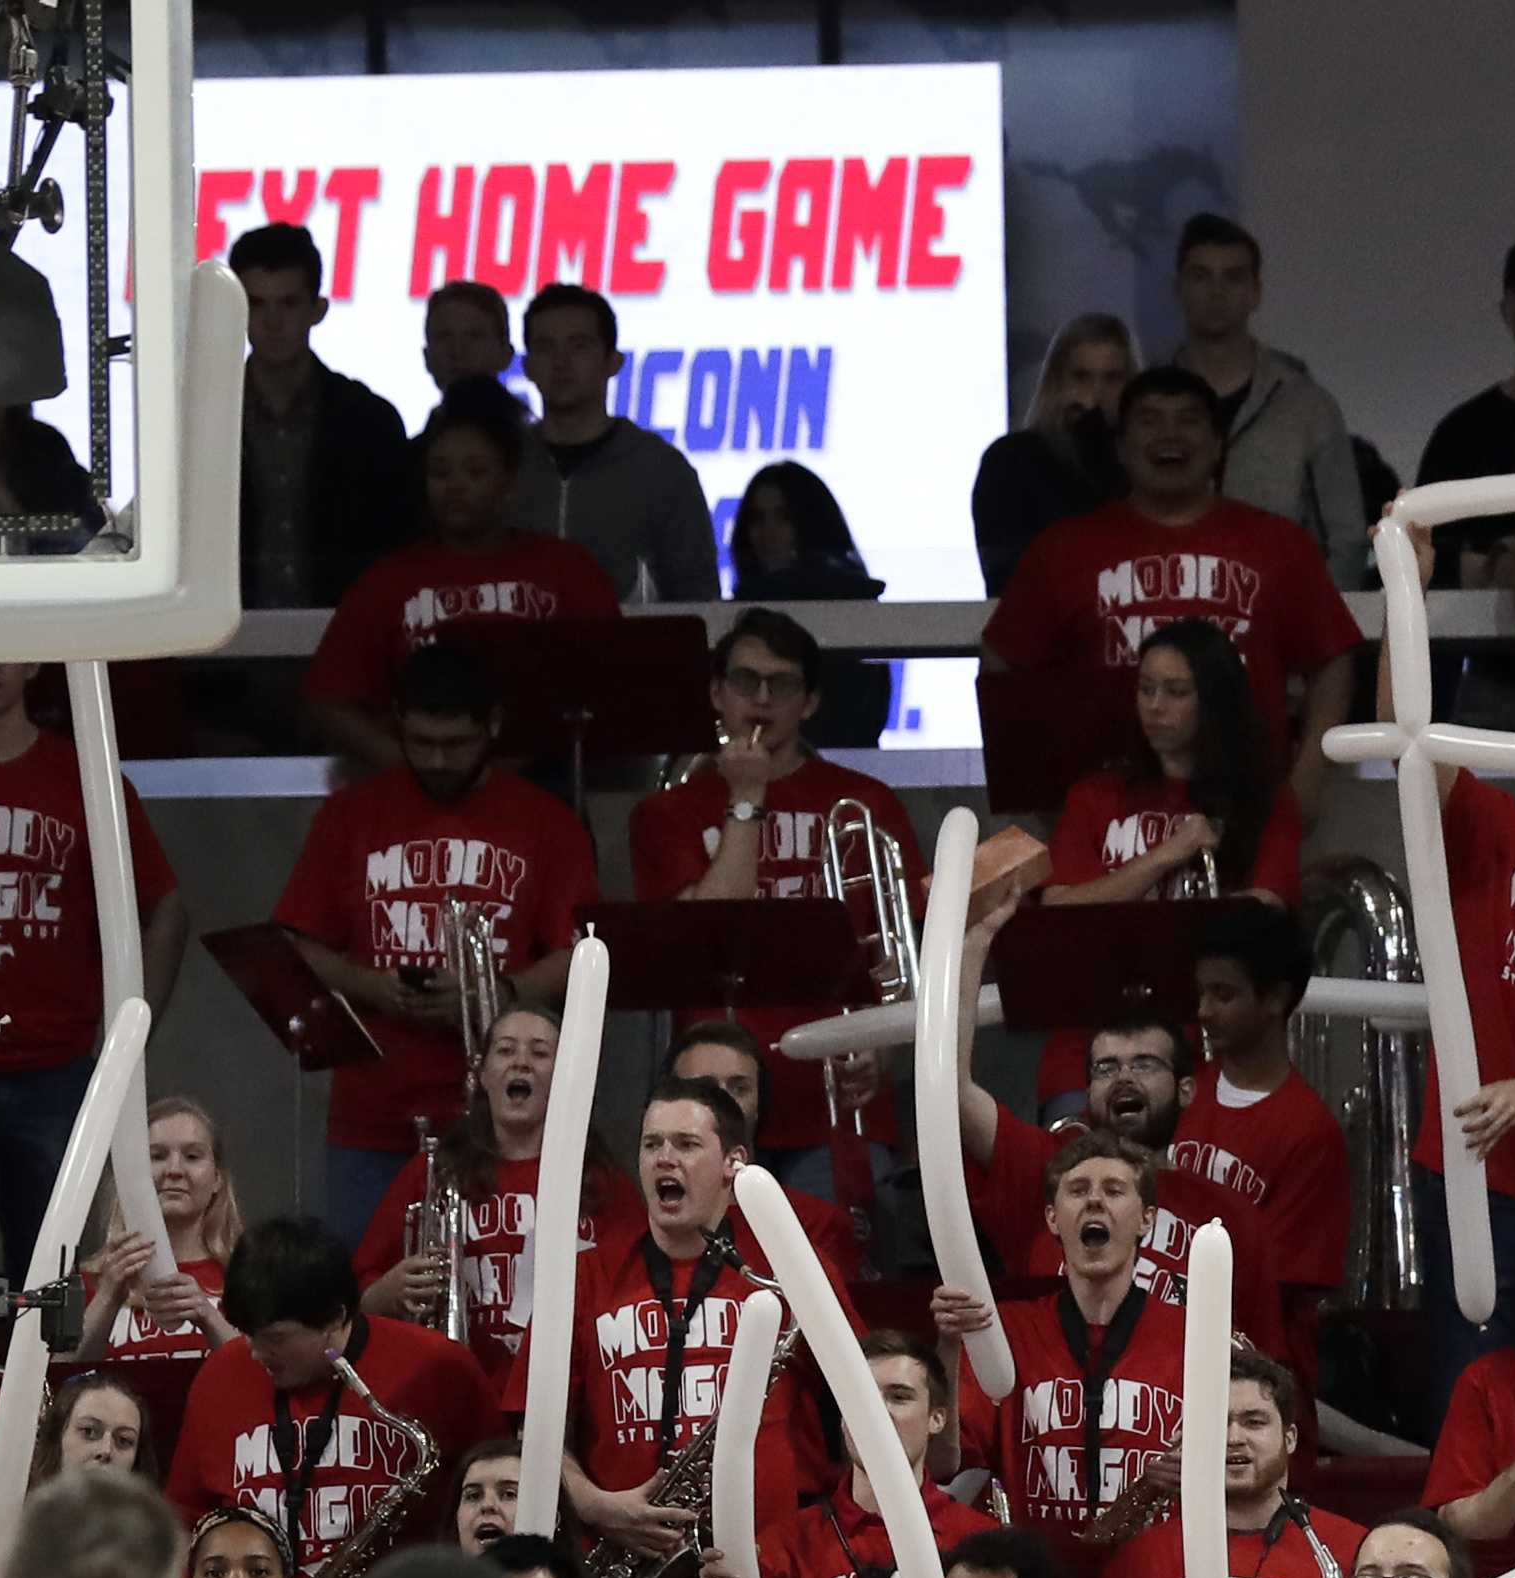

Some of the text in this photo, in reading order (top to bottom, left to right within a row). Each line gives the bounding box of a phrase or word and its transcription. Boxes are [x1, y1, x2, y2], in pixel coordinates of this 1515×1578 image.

[195, 167, 380, 300] EXT
[409, 161, 677, 298] HOME
[706, 155, 972, 292] GAME
[1098, 553, 1260, 616] MOODY
[366, 838, 525, 900] MOODY
[23, 924, 60, 939] OUT
[617, 1424, 701, 1445] STRPE
